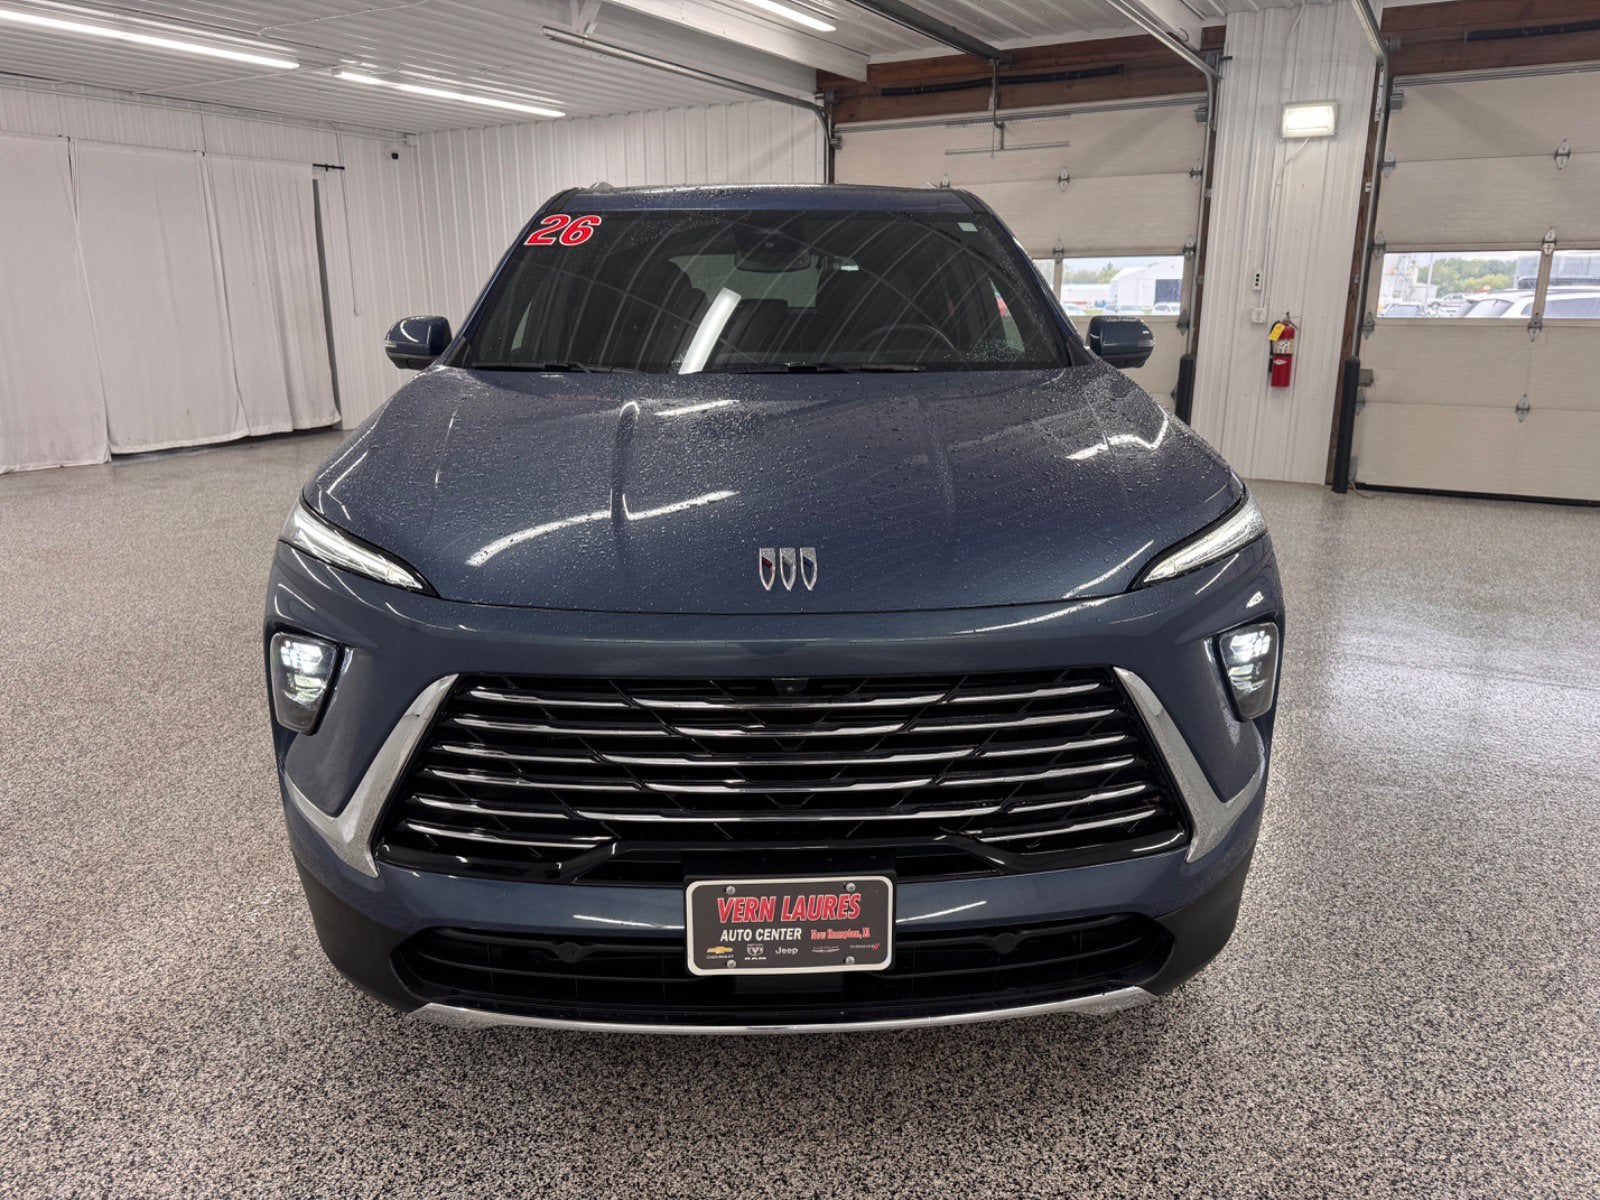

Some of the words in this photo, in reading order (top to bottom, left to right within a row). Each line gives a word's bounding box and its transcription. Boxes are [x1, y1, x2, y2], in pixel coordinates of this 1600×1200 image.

[523, 214, 602, 246] 26
[717, 895, 776, 923] VERN
[781, 893, 862, 922] LAURES
[720, 928, 753, 942] AUTO
[755, 927, 802, 941] CENTER
[811, 929, 826, 940] New
[775, 946, 798, 955] Jeep
